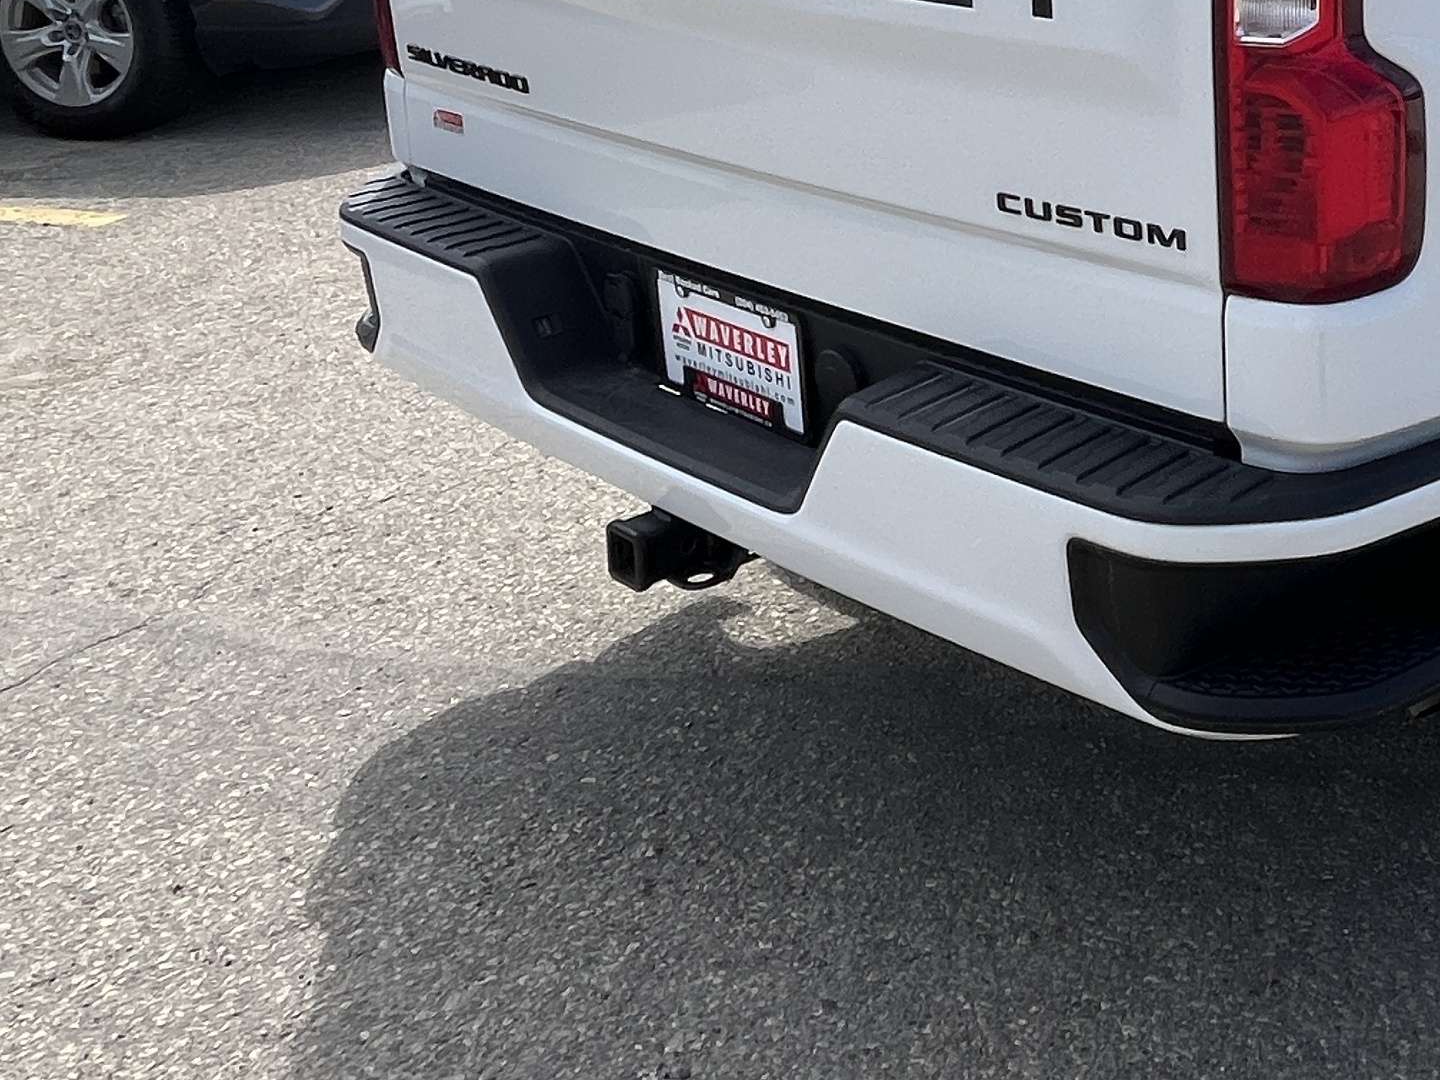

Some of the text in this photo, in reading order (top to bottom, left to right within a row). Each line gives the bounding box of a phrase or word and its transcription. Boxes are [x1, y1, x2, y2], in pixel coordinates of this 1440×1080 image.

[406, 43, 530, 94] SILVERADO
[996, 191, 1187, 252] CUSTOM
[692, 314, 787, 368] WAVERLEY
[697, 341, 791, 391] MITSUBISHI
[707, 377, 769, 416] WAVERLEY
